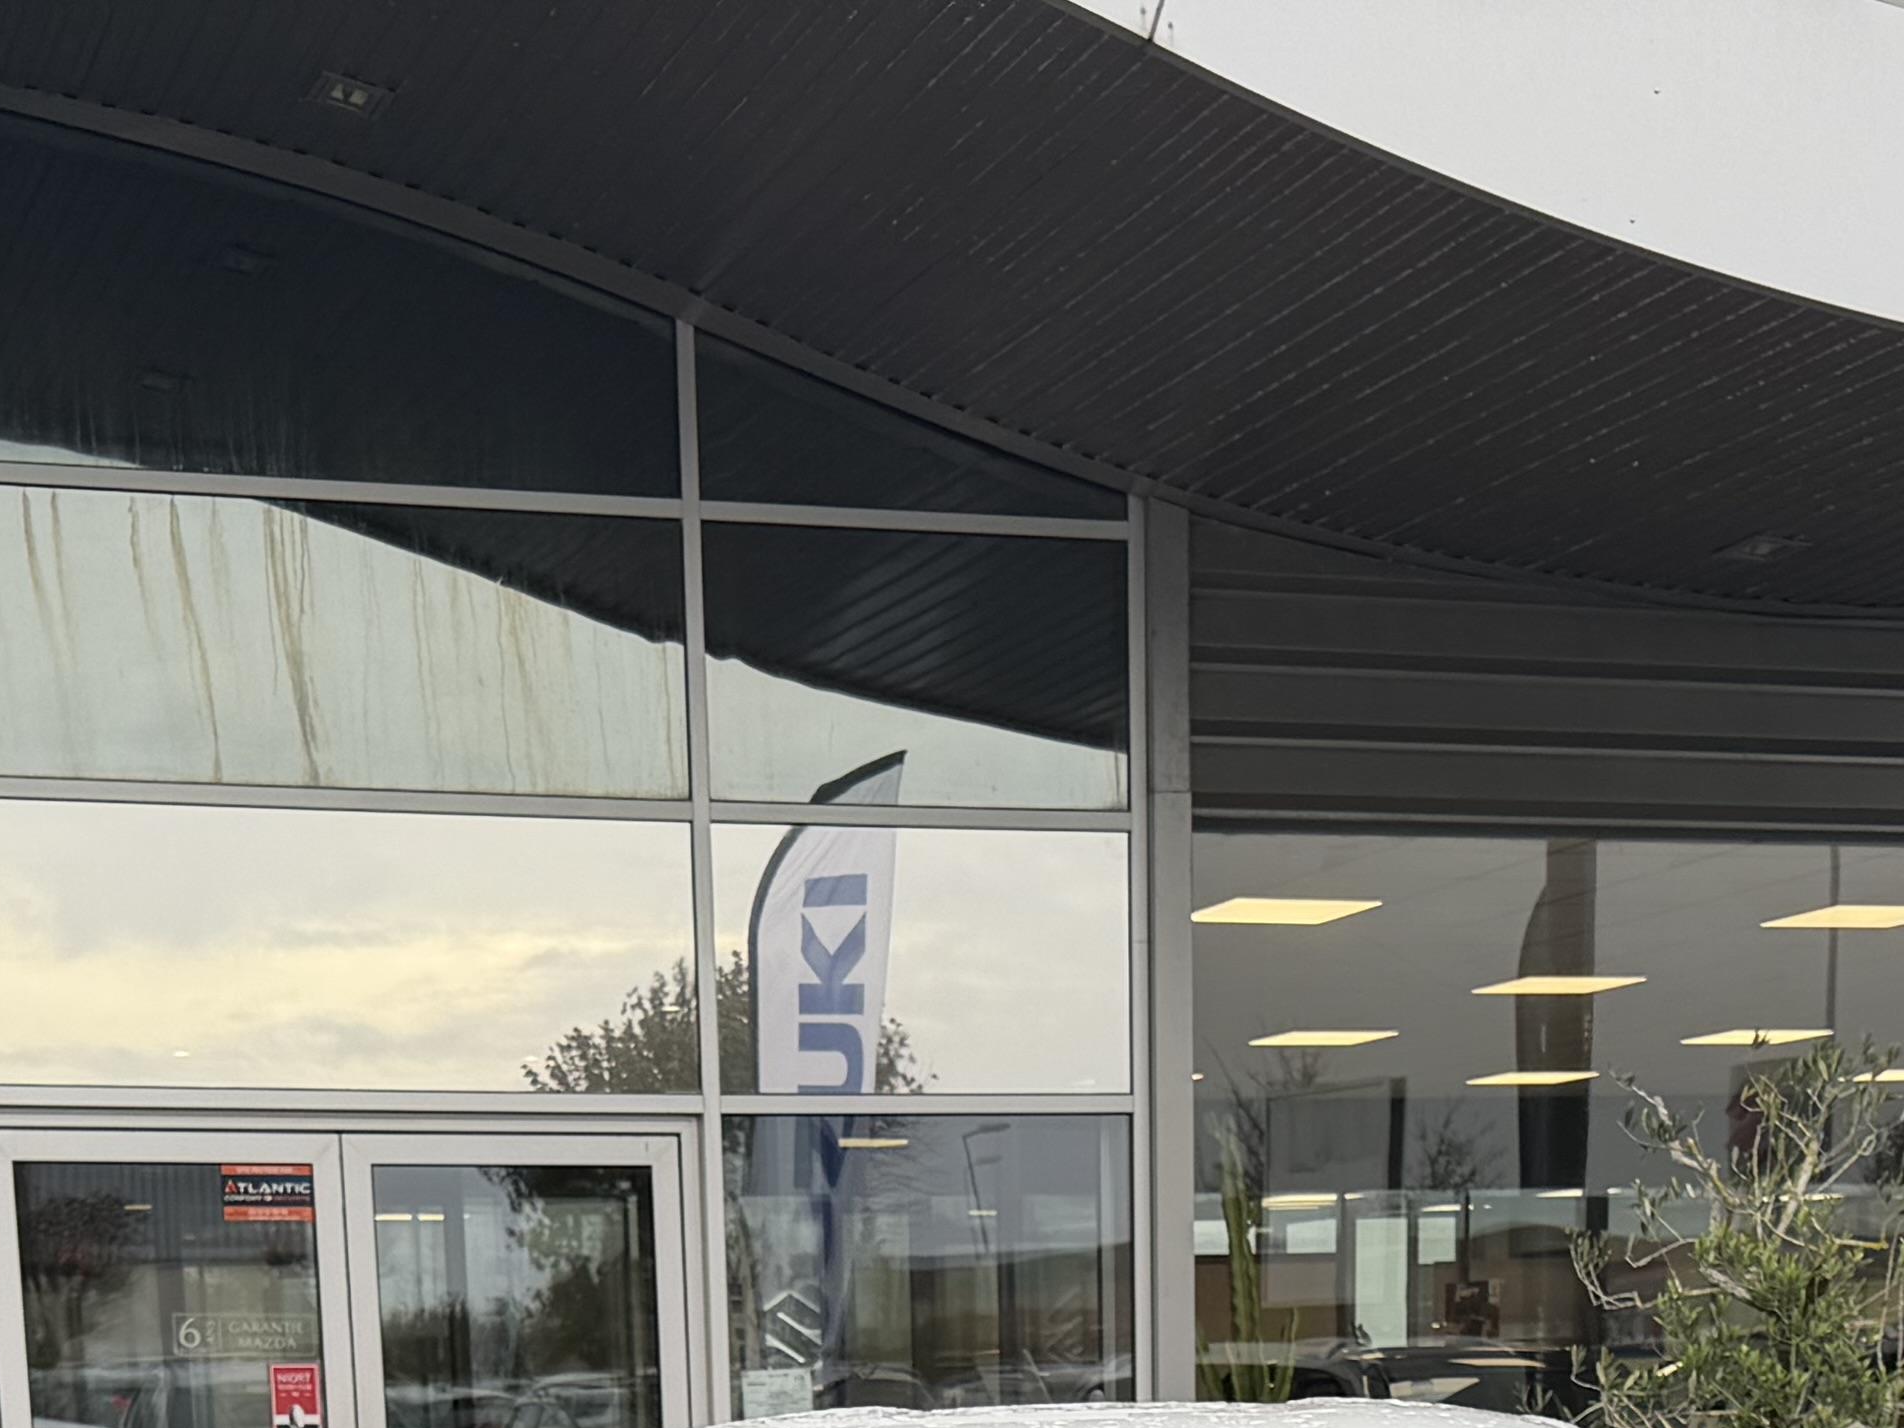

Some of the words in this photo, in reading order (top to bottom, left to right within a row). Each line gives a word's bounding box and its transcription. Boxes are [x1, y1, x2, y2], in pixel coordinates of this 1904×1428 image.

[224, 1179, 311, 1194] ATLANTIC
[178, 1317, 202, 1348] 6
[228, 1319, 304, 1335] GARANTIE
[237, 1336, 297, 1350] MAZDA
